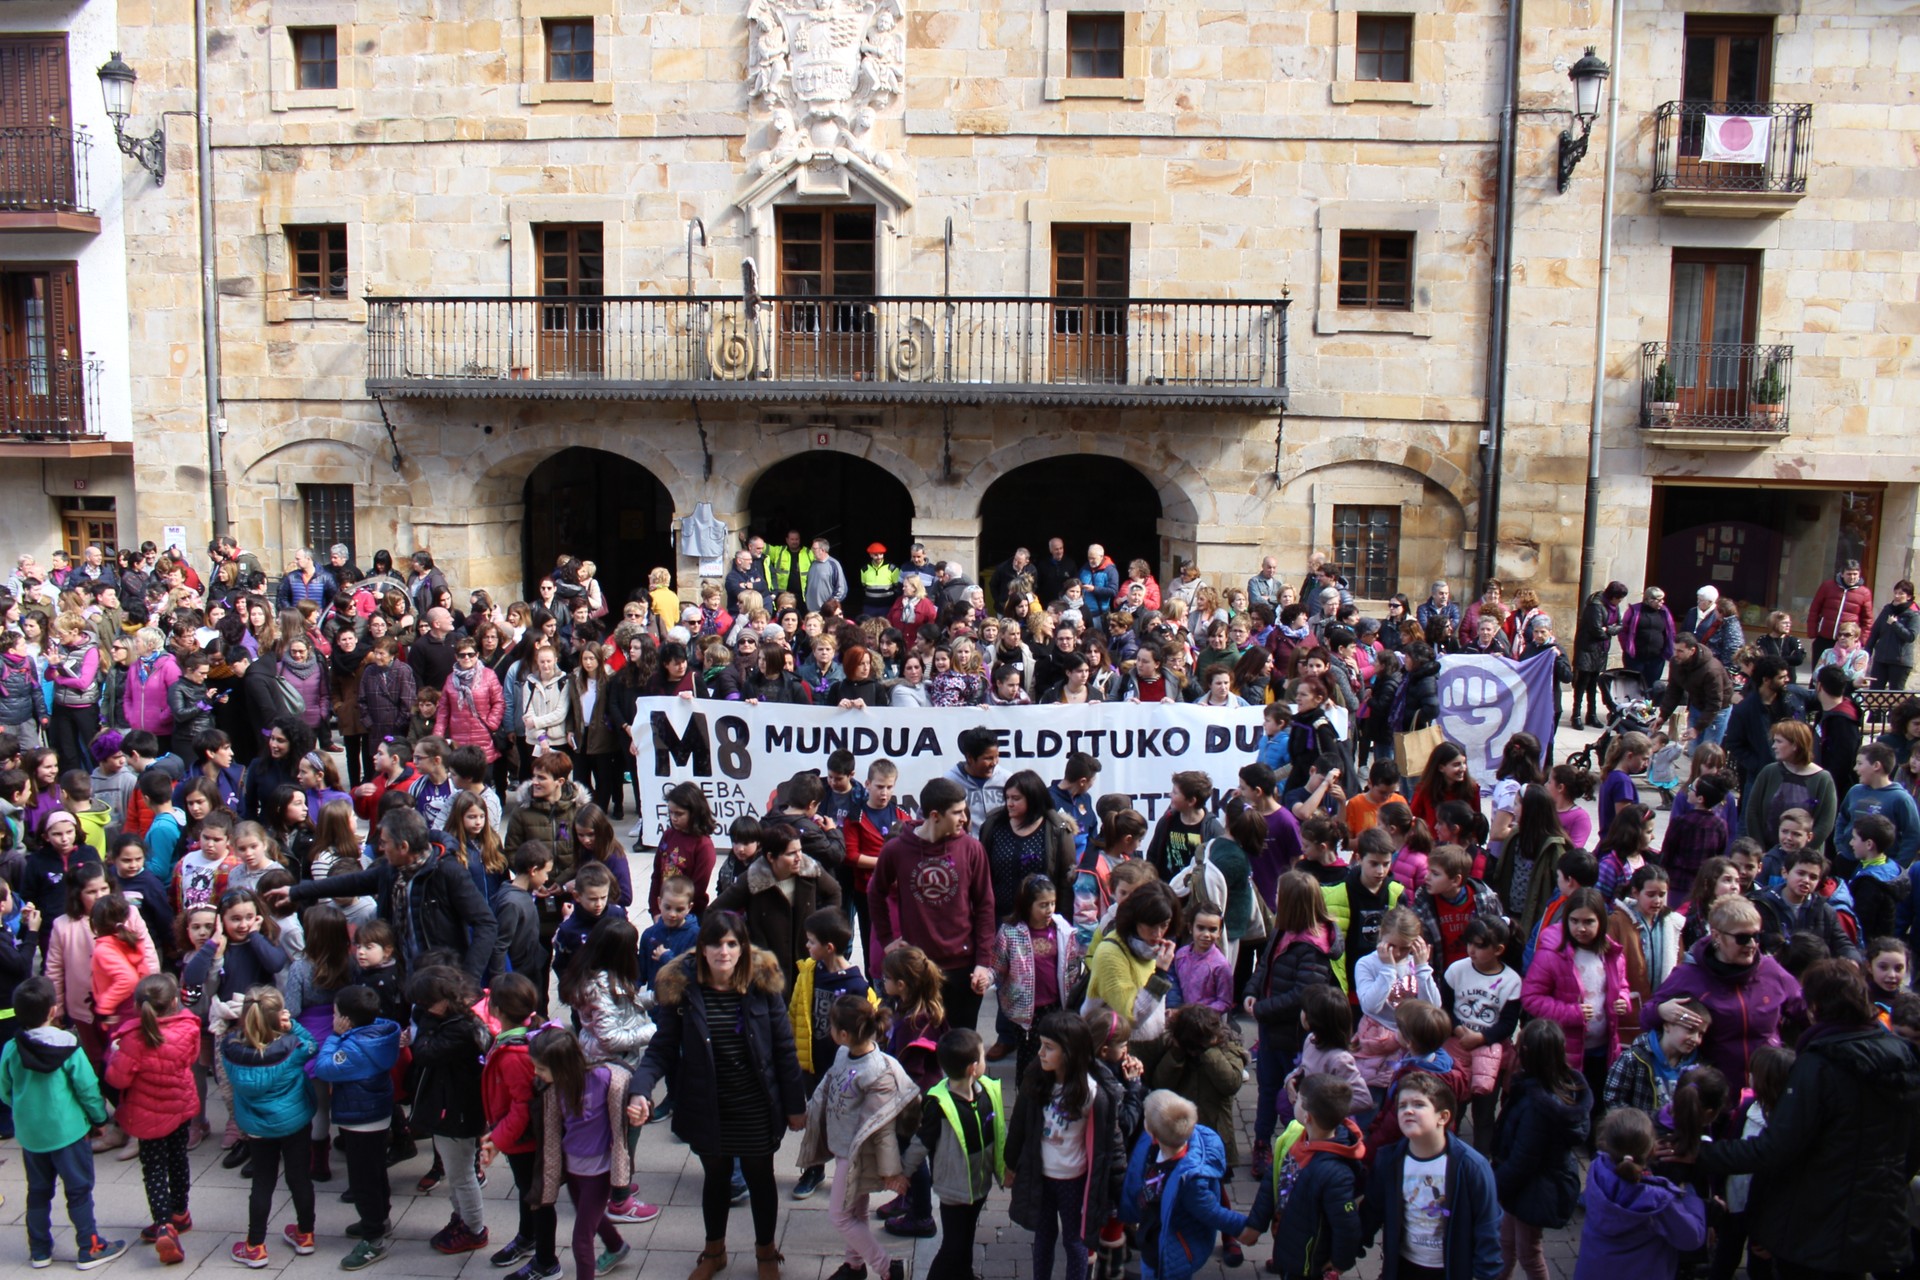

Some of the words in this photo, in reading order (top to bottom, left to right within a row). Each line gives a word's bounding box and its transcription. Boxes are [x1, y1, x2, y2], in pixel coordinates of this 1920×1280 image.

[819, 435, 826, 444] 8
[650, 710, 752, 780] M8
[765, 724, 942, 757] MUNDUA
[957, 727, 1191, 758] ELDITUKO
[662, 782, 745, 798] EBA
[969, 787, 1005, 806] ANS
[1467, 989, 1488, 998] LIKE
[1490, 993, 1500, 1004] TO
